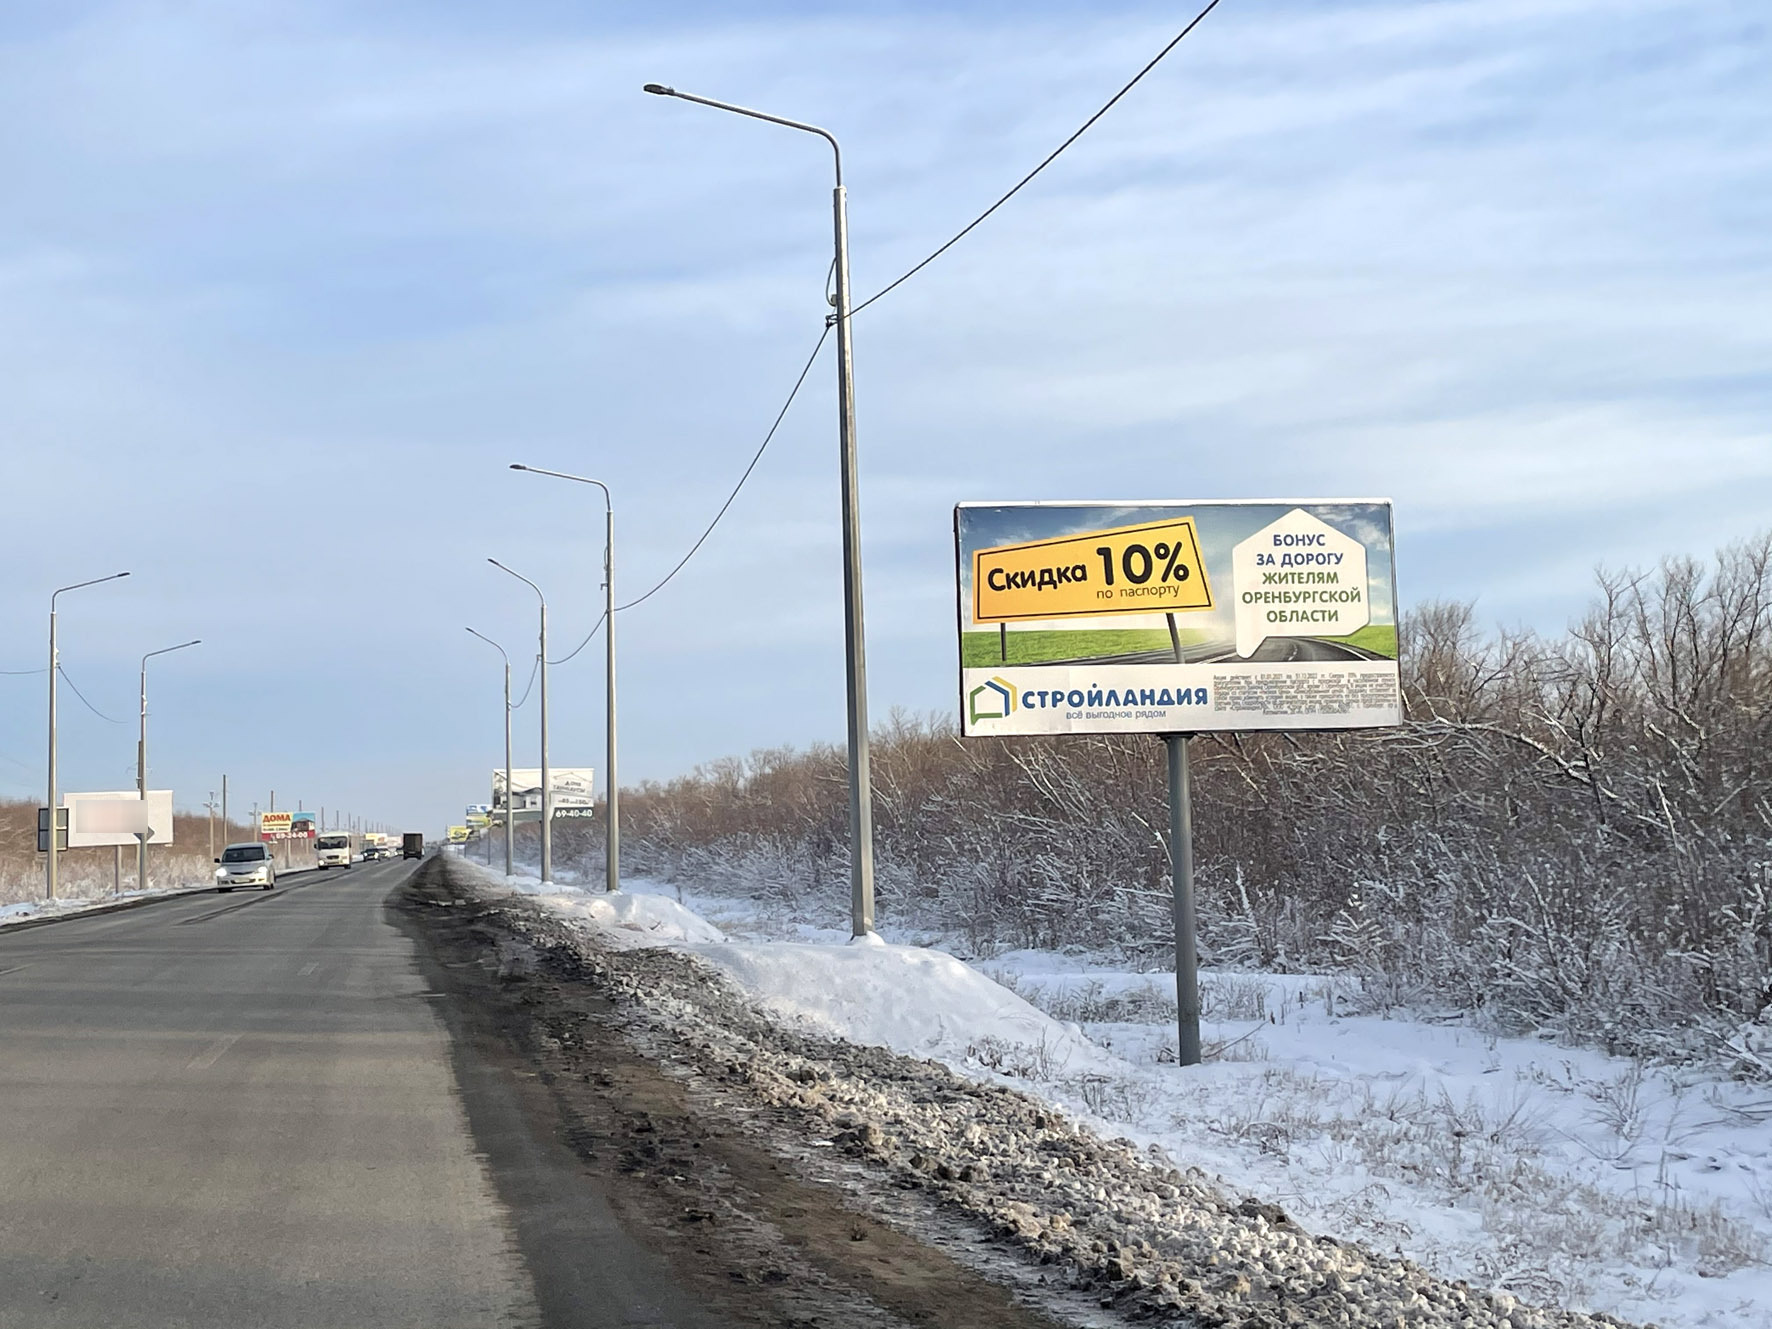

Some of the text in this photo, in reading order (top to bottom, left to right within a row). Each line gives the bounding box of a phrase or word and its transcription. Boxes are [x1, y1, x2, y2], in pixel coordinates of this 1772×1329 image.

[1273, 534, 1326, 546] БОНУС
[988, 541, 1190, 592] Скидка 10%
[1256, 552, 1344, 568] ЗА ДОРОГУ
[1262, 571, 1339, 585] ЖИТЕЛЯМ
[1097, 584, 1181, 599] по паспорту
[1242, 586, 1361, 604] ОРЕНБУРГСКОЙ
[1267, 610, 1338, 622] ОБЛАСТИ
[1022, 683, 1208, 709] СТРОЙЛАНДИЯ
[1066, 710, 1167, 721] всё выгодное рядом
[263, 814, 291, 823] ДОМА
[555, 809, 593, 818] 69-40-40
